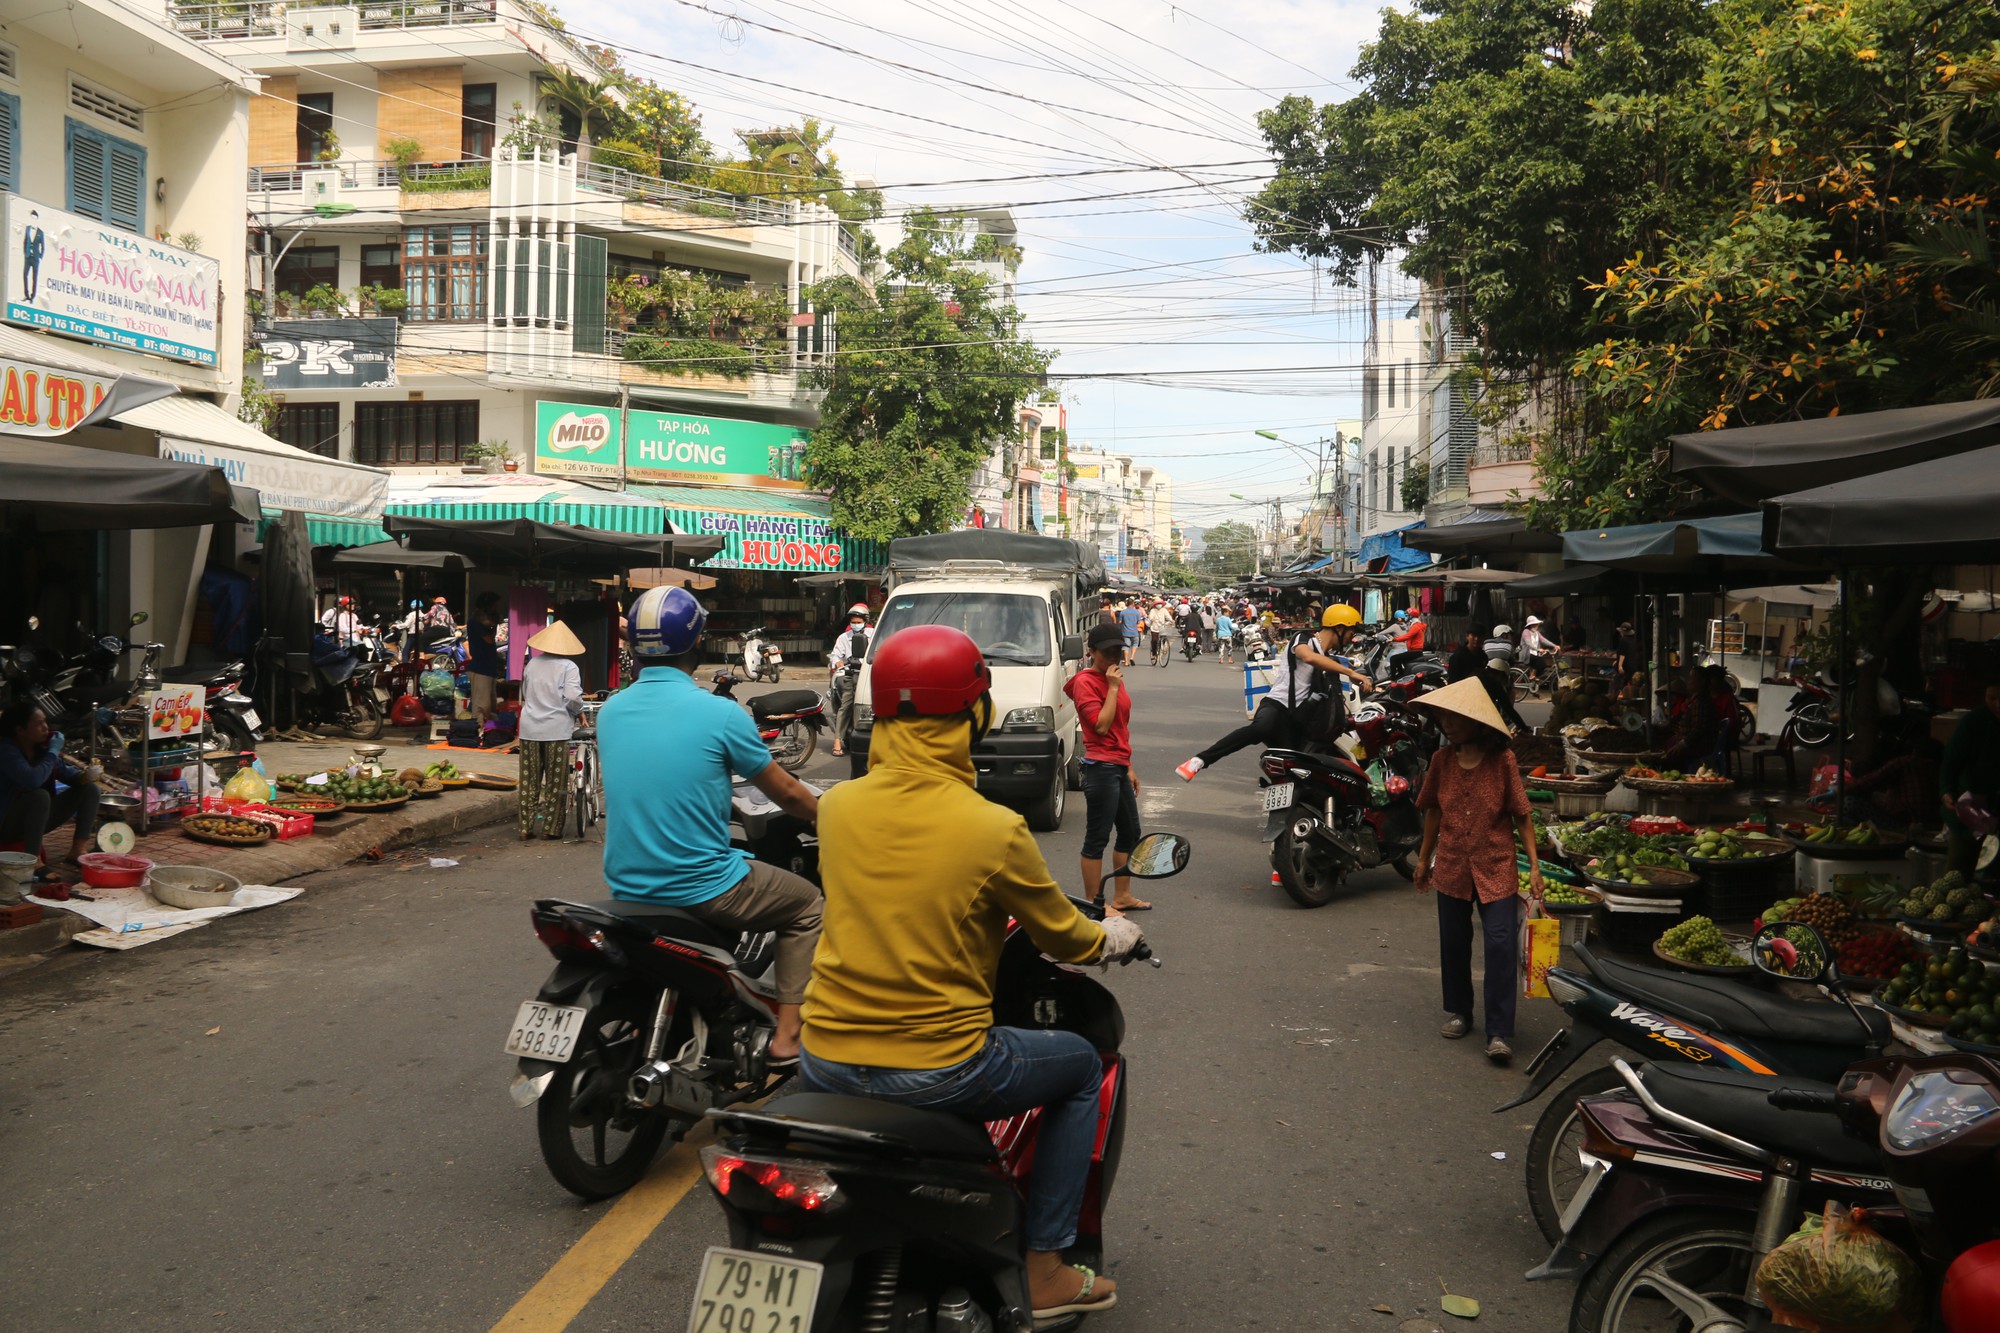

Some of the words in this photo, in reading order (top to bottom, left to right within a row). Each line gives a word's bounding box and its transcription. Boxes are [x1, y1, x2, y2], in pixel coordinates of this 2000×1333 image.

[98, 231, 142, 254] NHÀ
[149, 247, 191, 268] MAY
[59, 247, 144, 293] HOÀNG
[156, 274, 206, 311] NAM
[47, 277, 79, 296] CHUYÊN:
[80, 286, 96, 301] MAY
[97, 289, 106, 303] VÀ
[108, 292, 122, 308] BÁN
[134, 301, 152, 316] PHỤC
[153, 306, 167, 319] NAM
[66, 303, 90, 317] ĐẶC
[12, 308, 31, 321] ĐC:
[33, 313, 52, 326] 130
[54, 317, 67, 330] Võ
[94, 326, 110, 340] Nha
[112, 331, 137, 347] Trang
[143, 339, 158, 351] ĐT:
[159, 342, 179, 355] 0907
[181, 347, 196, 359] 580
[198, 351, 213, 362] 166
[260, 340, 354, 376] PK
[0, 366, 38, 427] AI
[557, 424, 605, 442] MILO
[656, 419, 680, 435] TẠP
[682, 421, 711, 436] HÓA
[564, 463, 577, 471] 126
[639, 439, 727, 466] HƯƠNG
[701, 514, 740, 533] CỬA
[746, 518, 798, 536] HÀNG
[803, 523, 836, 540] TẠP
[741, 537, 842, 568] HƯƠNG
[154, 697, 176, 711] Cam
[1266, 796, 1288, 809] 9983
[1610, 1002, 1697, 1040] Wave
[510, 1028, 571, 1058] 398.92
[758, 1242, 794, 1254] HONDA
[716, 1257, 800, 1307] 79-N1
